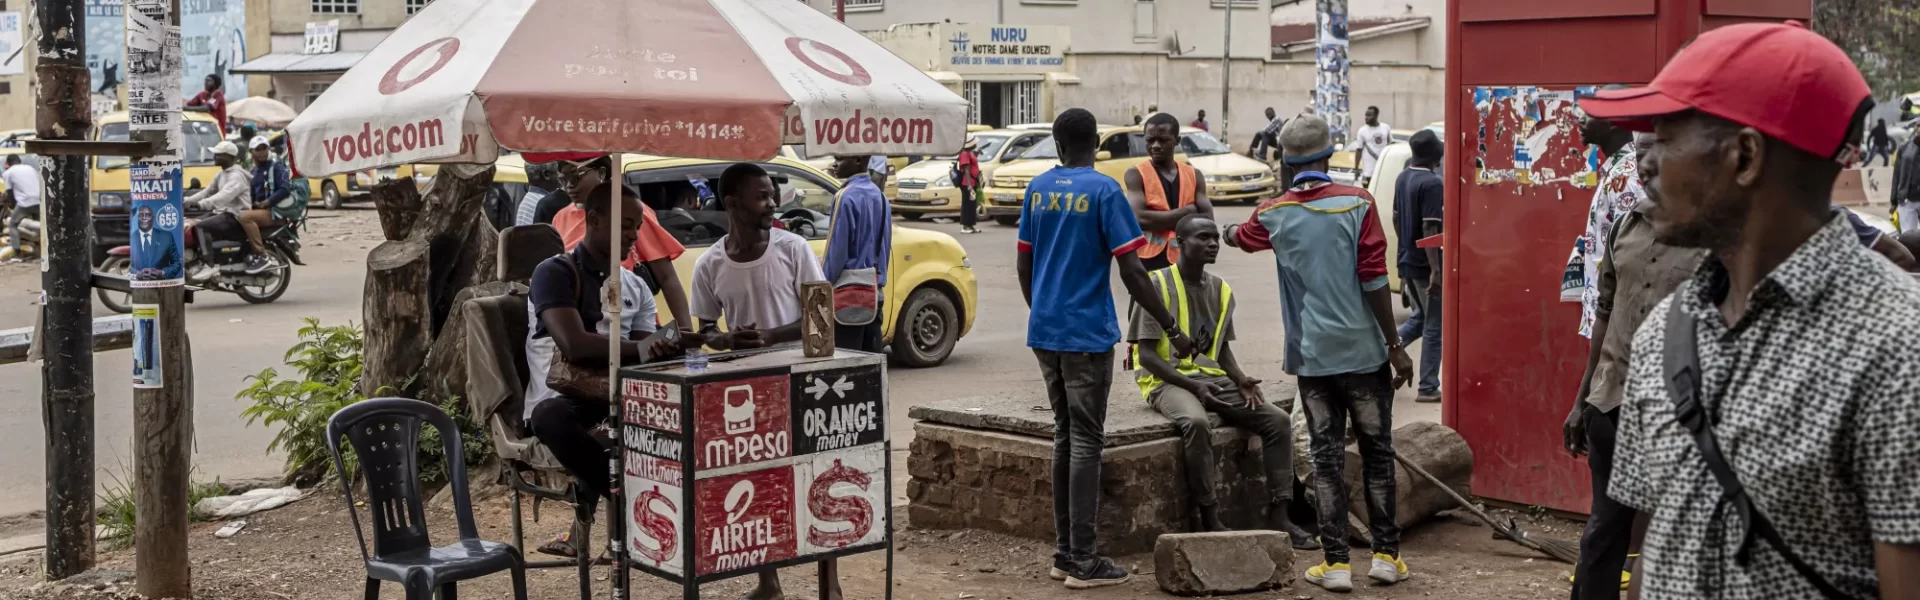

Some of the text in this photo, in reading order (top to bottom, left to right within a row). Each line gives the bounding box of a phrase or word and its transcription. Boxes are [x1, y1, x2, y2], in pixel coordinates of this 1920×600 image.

[991, 27, 1027, 42] NURU
[972, 44, 1051, 54] NOTRE DAME KOLWEZI
[972, 57, 982, 65] DES
[985, 57, 1005, 65] FEMMES
[654, 67, 698, 81] toi
[522, 115, 574, 133] Votre
[577, 117, 620, 133] tarif
[622, 119, 671, 138] privé
[815, 109, 933, 145] vodacom
[323, 118, 444, 164] vodacom
[1031, 192, 1089, 212] P.X16
[159, 212, 177, 226] 655
[803, 401, 877, 437] ORANGE
[623, 425, 682, 462] ORANGE money
[816, 431, 859, 452] money
[625, 449, 659, 480] AIRTEL
[710, 517, 777, 555] AIRTEL
[715, 546, 768, 573] money
